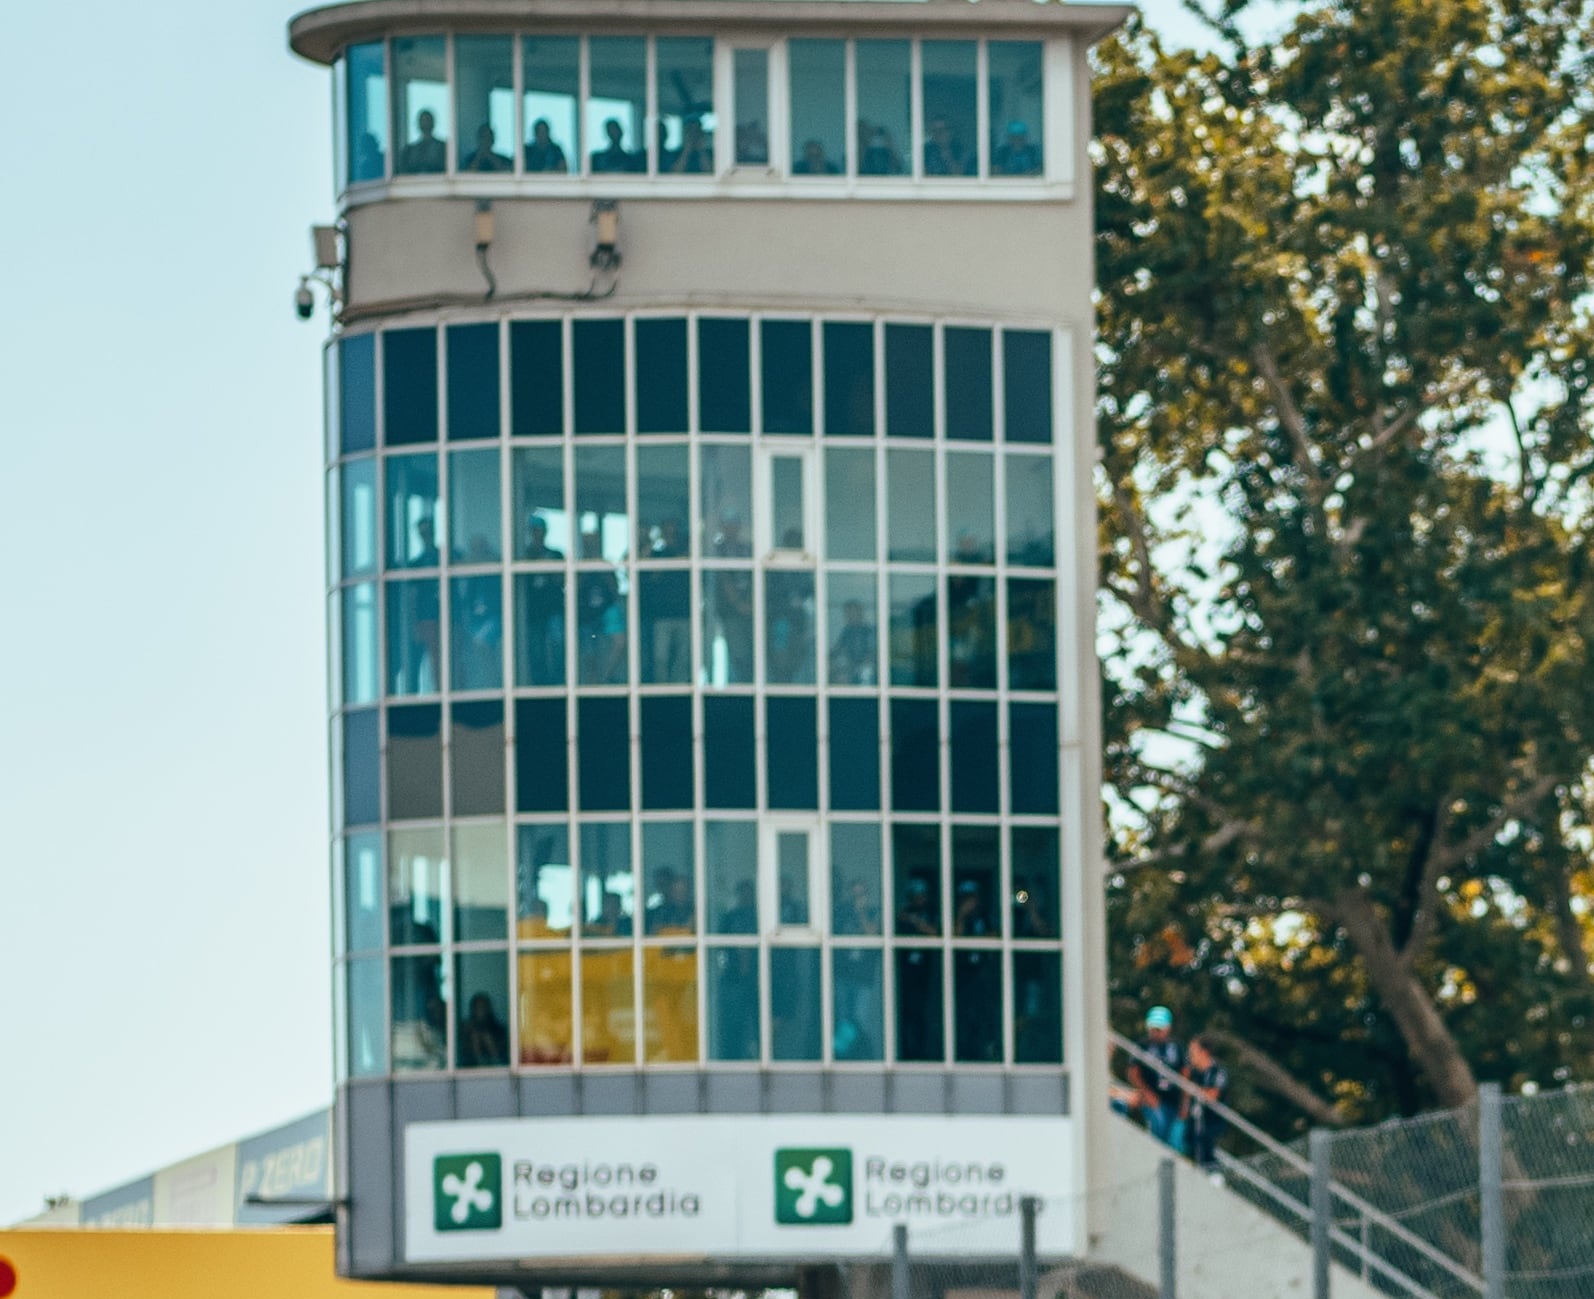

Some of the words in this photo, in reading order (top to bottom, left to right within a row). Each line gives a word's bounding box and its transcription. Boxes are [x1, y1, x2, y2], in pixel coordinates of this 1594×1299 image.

[513, 1160, 657, 1190] Regione
[867, 1157, 1003, 1188] Regione
[513, 1189, 699, 1217] Lombardia
